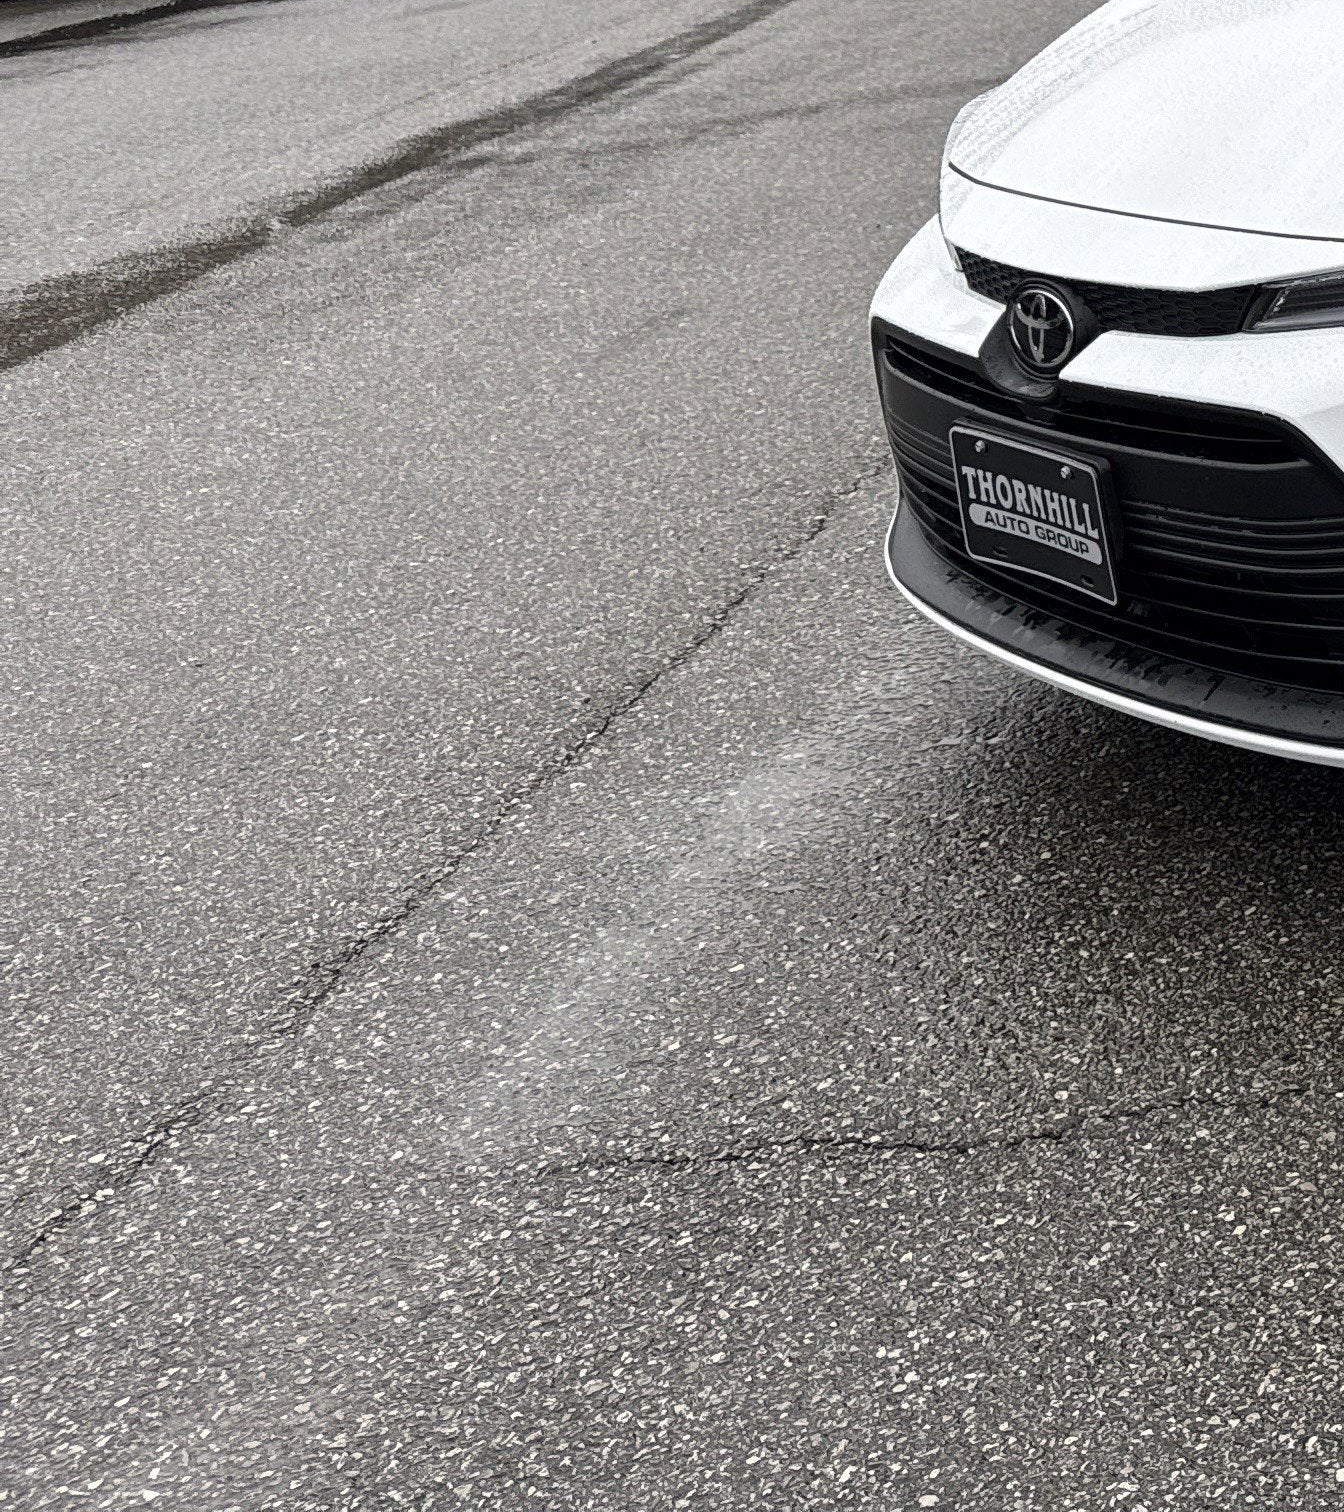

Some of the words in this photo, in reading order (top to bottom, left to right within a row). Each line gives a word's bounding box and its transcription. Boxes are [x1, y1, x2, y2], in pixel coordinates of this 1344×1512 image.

[961, 464, 1100, 540] THORNHILL
[984, 509, 1031, 536] AUTO
[1034, 524, 1090, 556] GROUP
